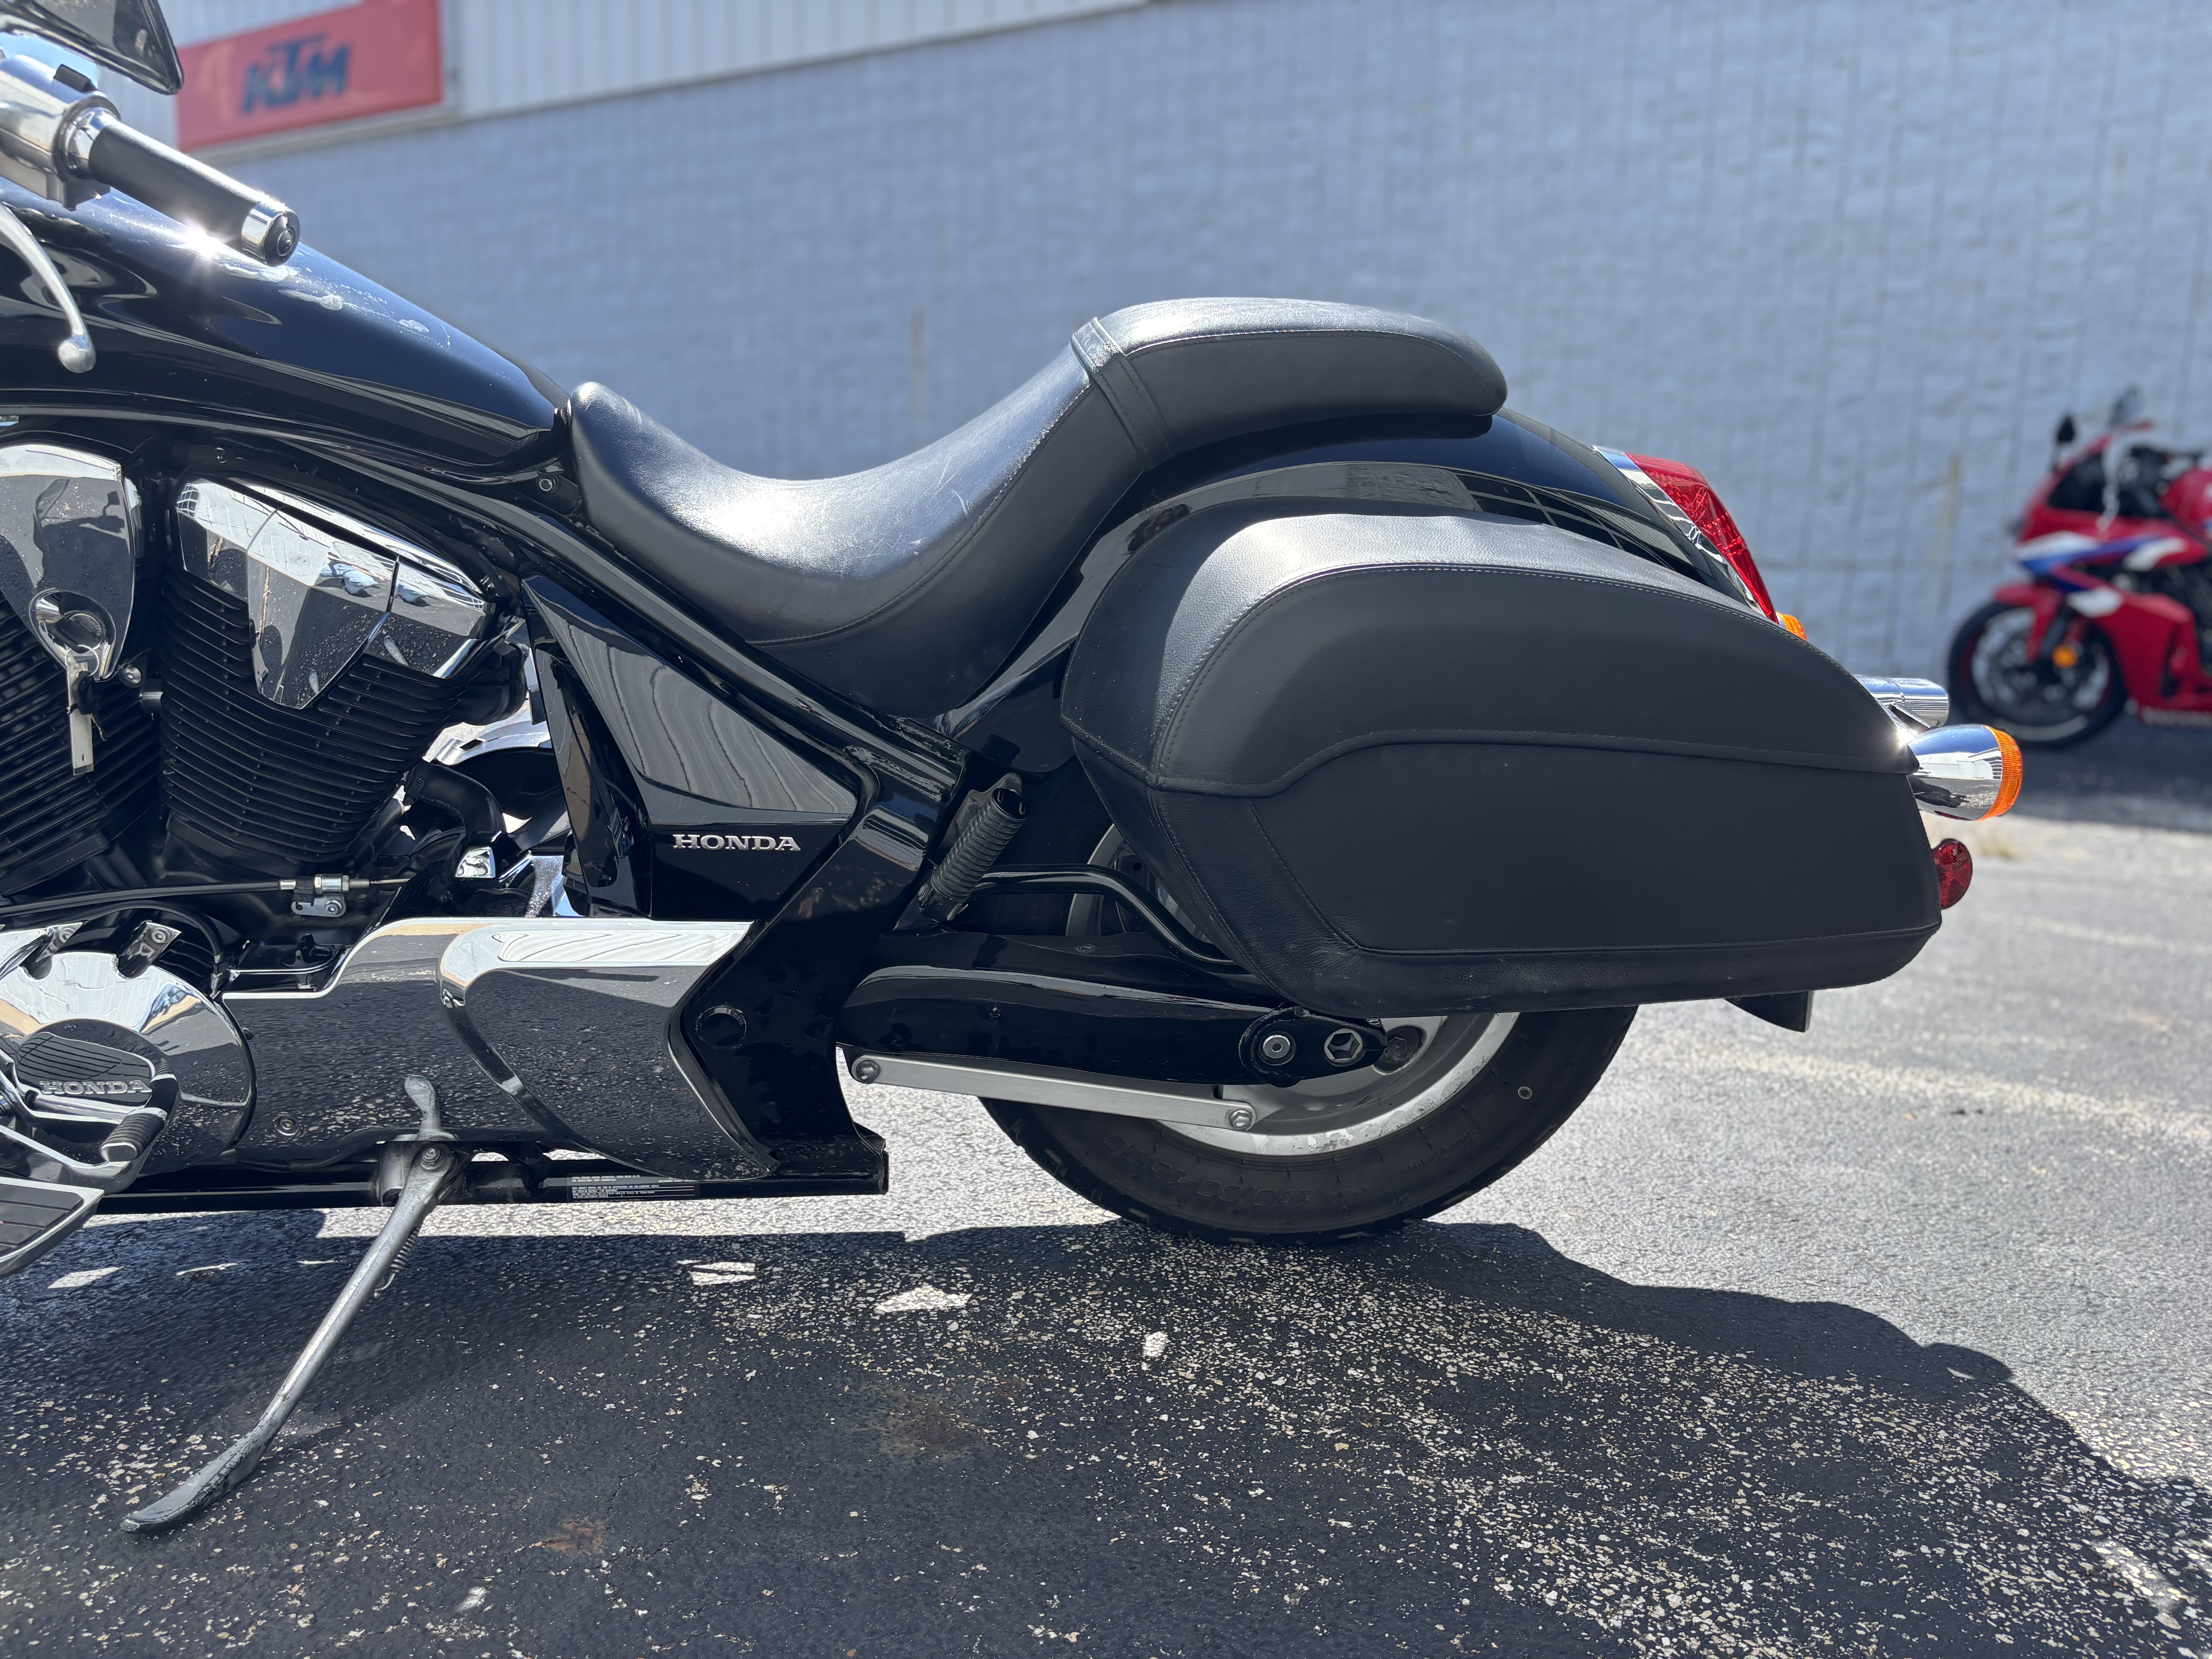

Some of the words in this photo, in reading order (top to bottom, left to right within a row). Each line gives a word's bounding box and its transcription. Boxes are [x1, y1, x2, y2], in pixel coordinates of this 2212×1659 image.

[241, 33, 351, 114] KTM
[672, 834, 801, 852] HONDA
[39, 1080, 153, 1095] HONDA
